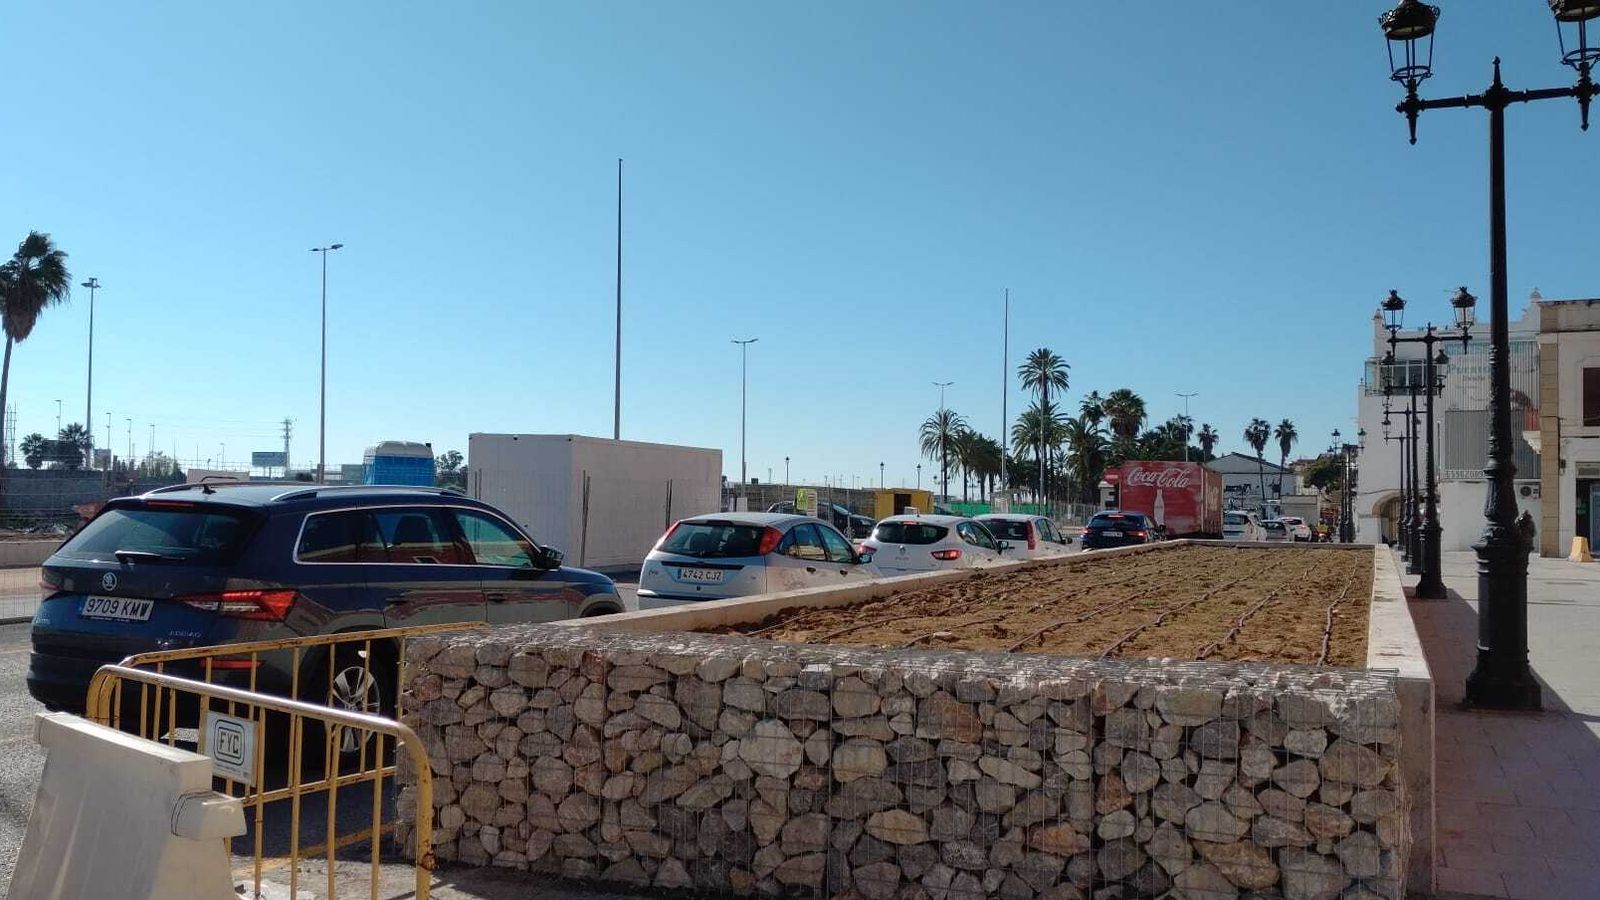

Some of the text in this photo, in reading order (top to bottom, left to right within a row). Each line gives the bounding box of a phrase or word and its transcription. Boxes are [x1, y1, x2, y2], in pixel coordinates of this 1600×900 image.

[86, 598, 151, 617] 9709 KMW
[219, 731, 240, 754] FYC
